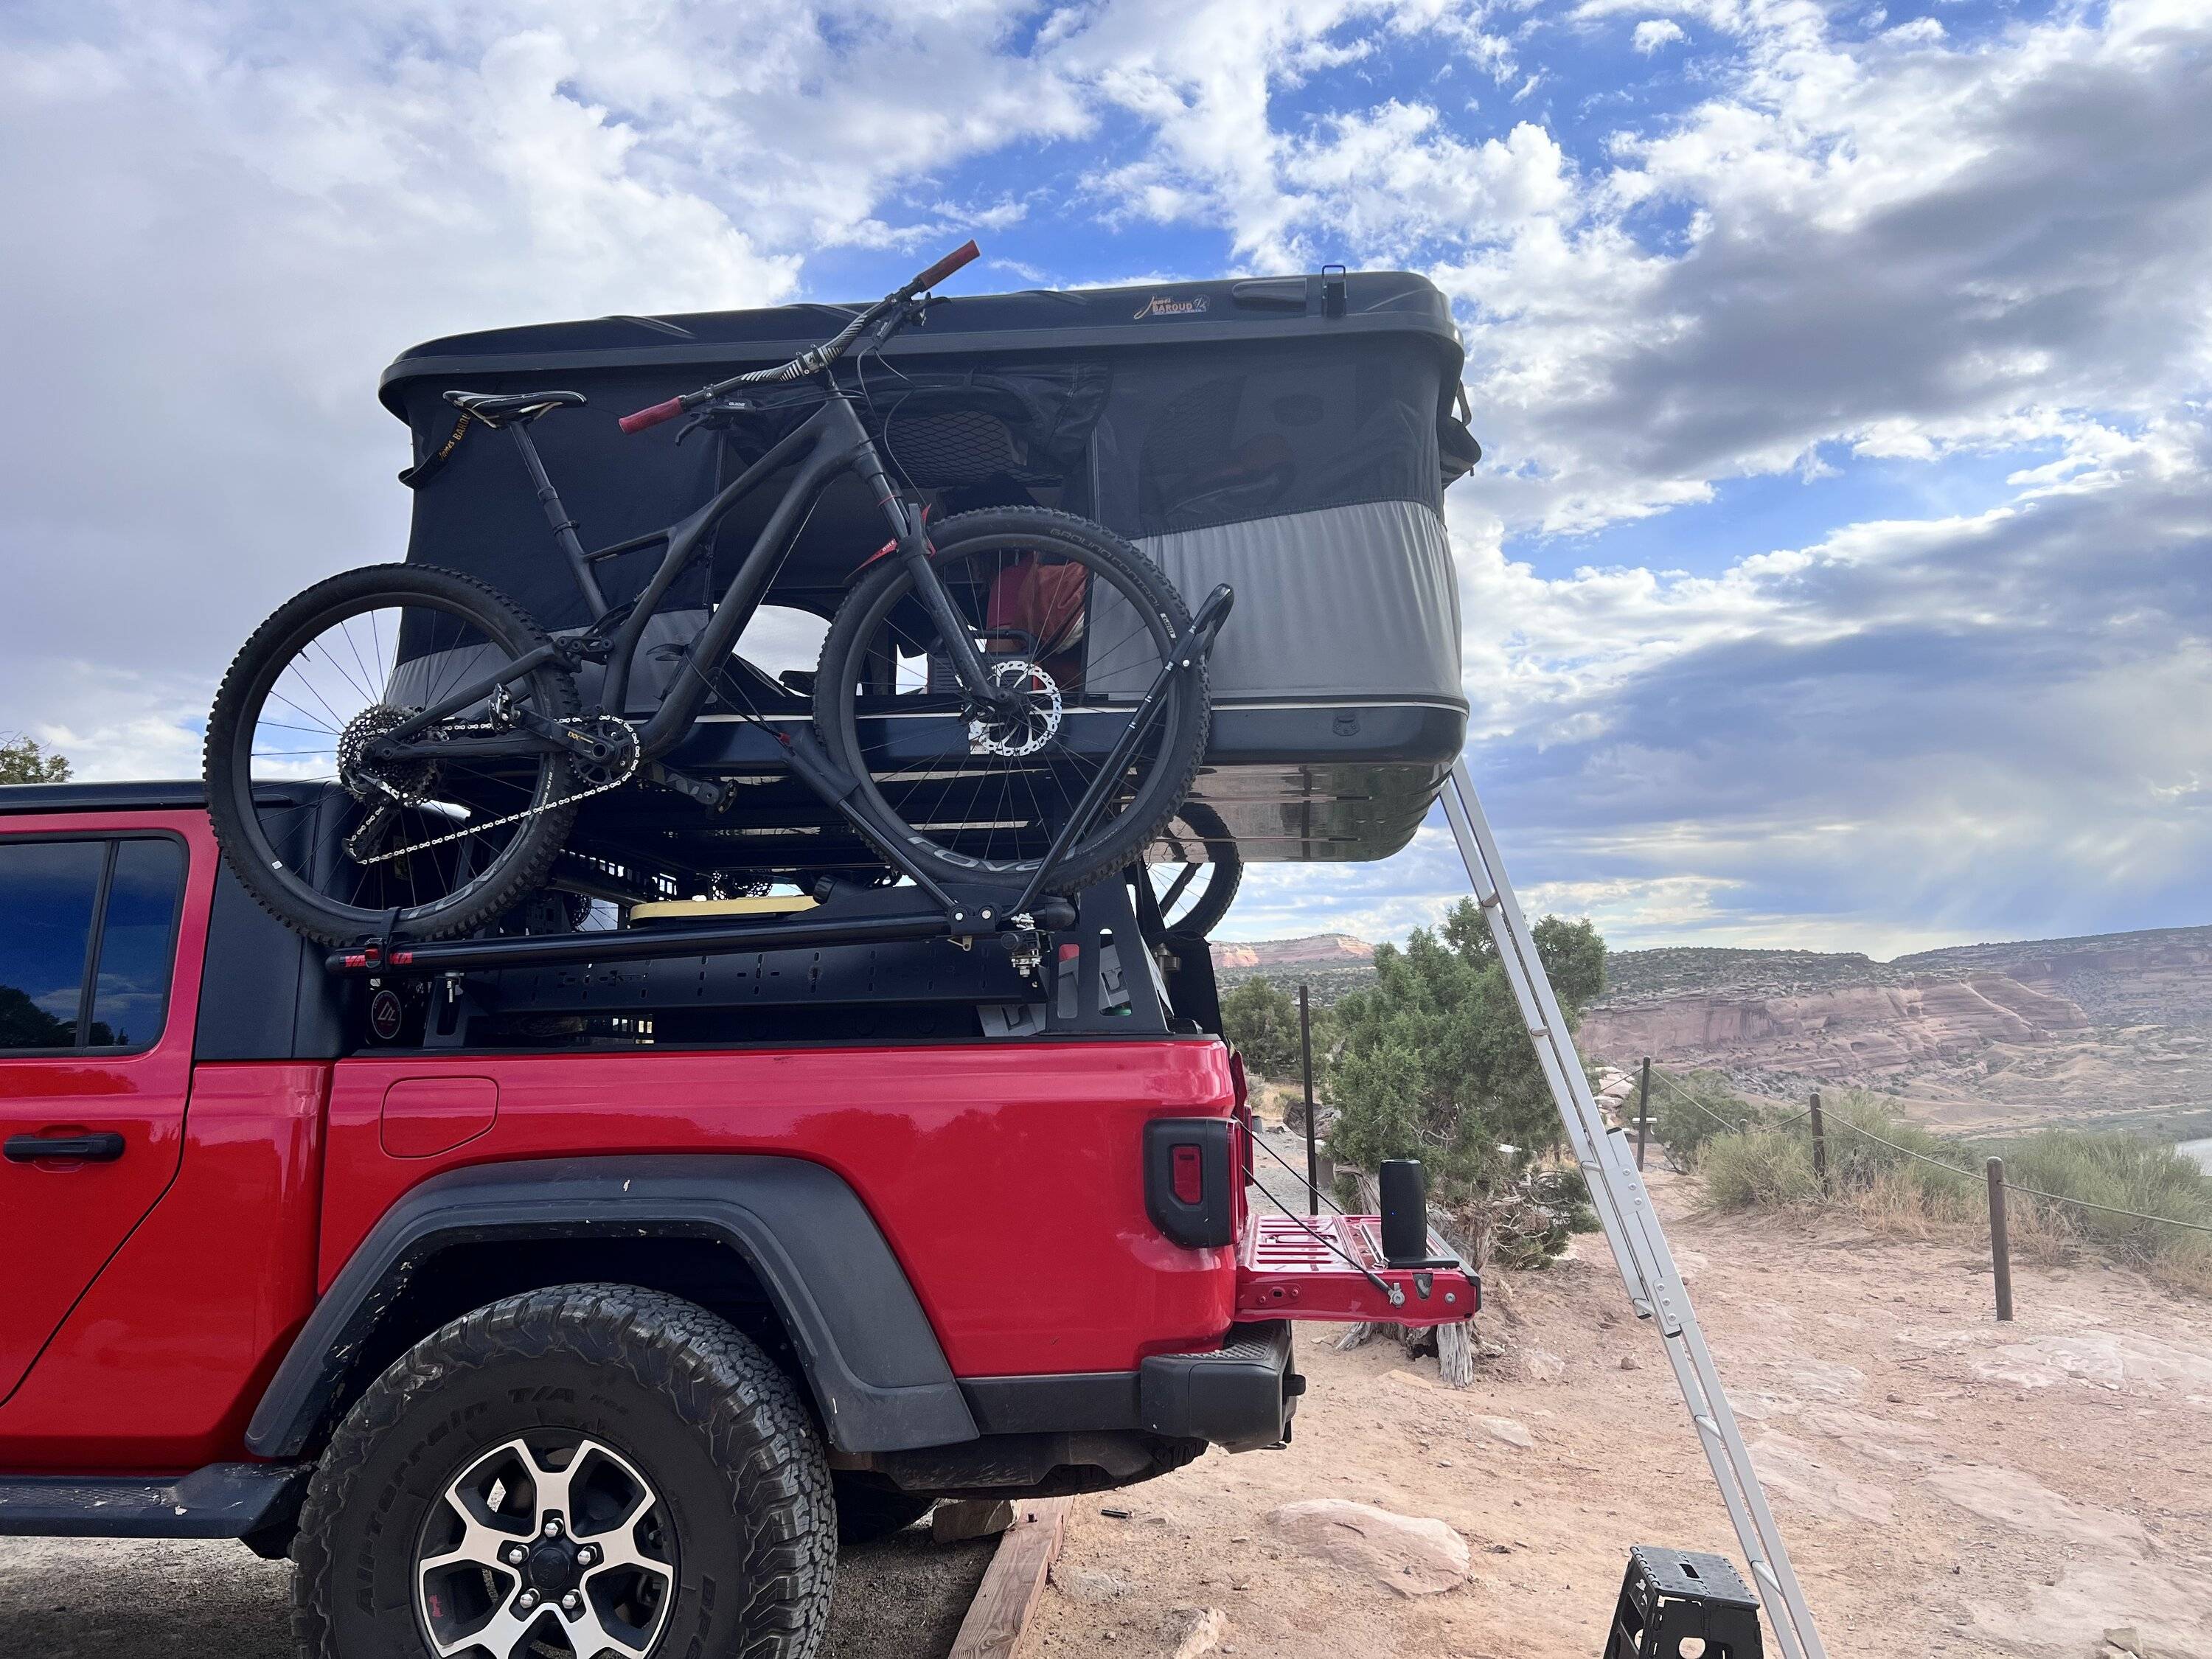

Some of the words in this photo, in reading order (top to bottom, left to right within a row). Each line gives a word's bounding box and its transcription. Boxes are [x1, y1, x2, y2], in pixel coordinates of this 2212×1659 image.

[1152, 303, 1193, 313] BAROUD
[452, 413, 472, 440] BAROU
[1050, 528, 1112, 558] GROUND
[1111, 556, 1160, 607] CONTROL
[507, 1385, 574, 1404] T/A
